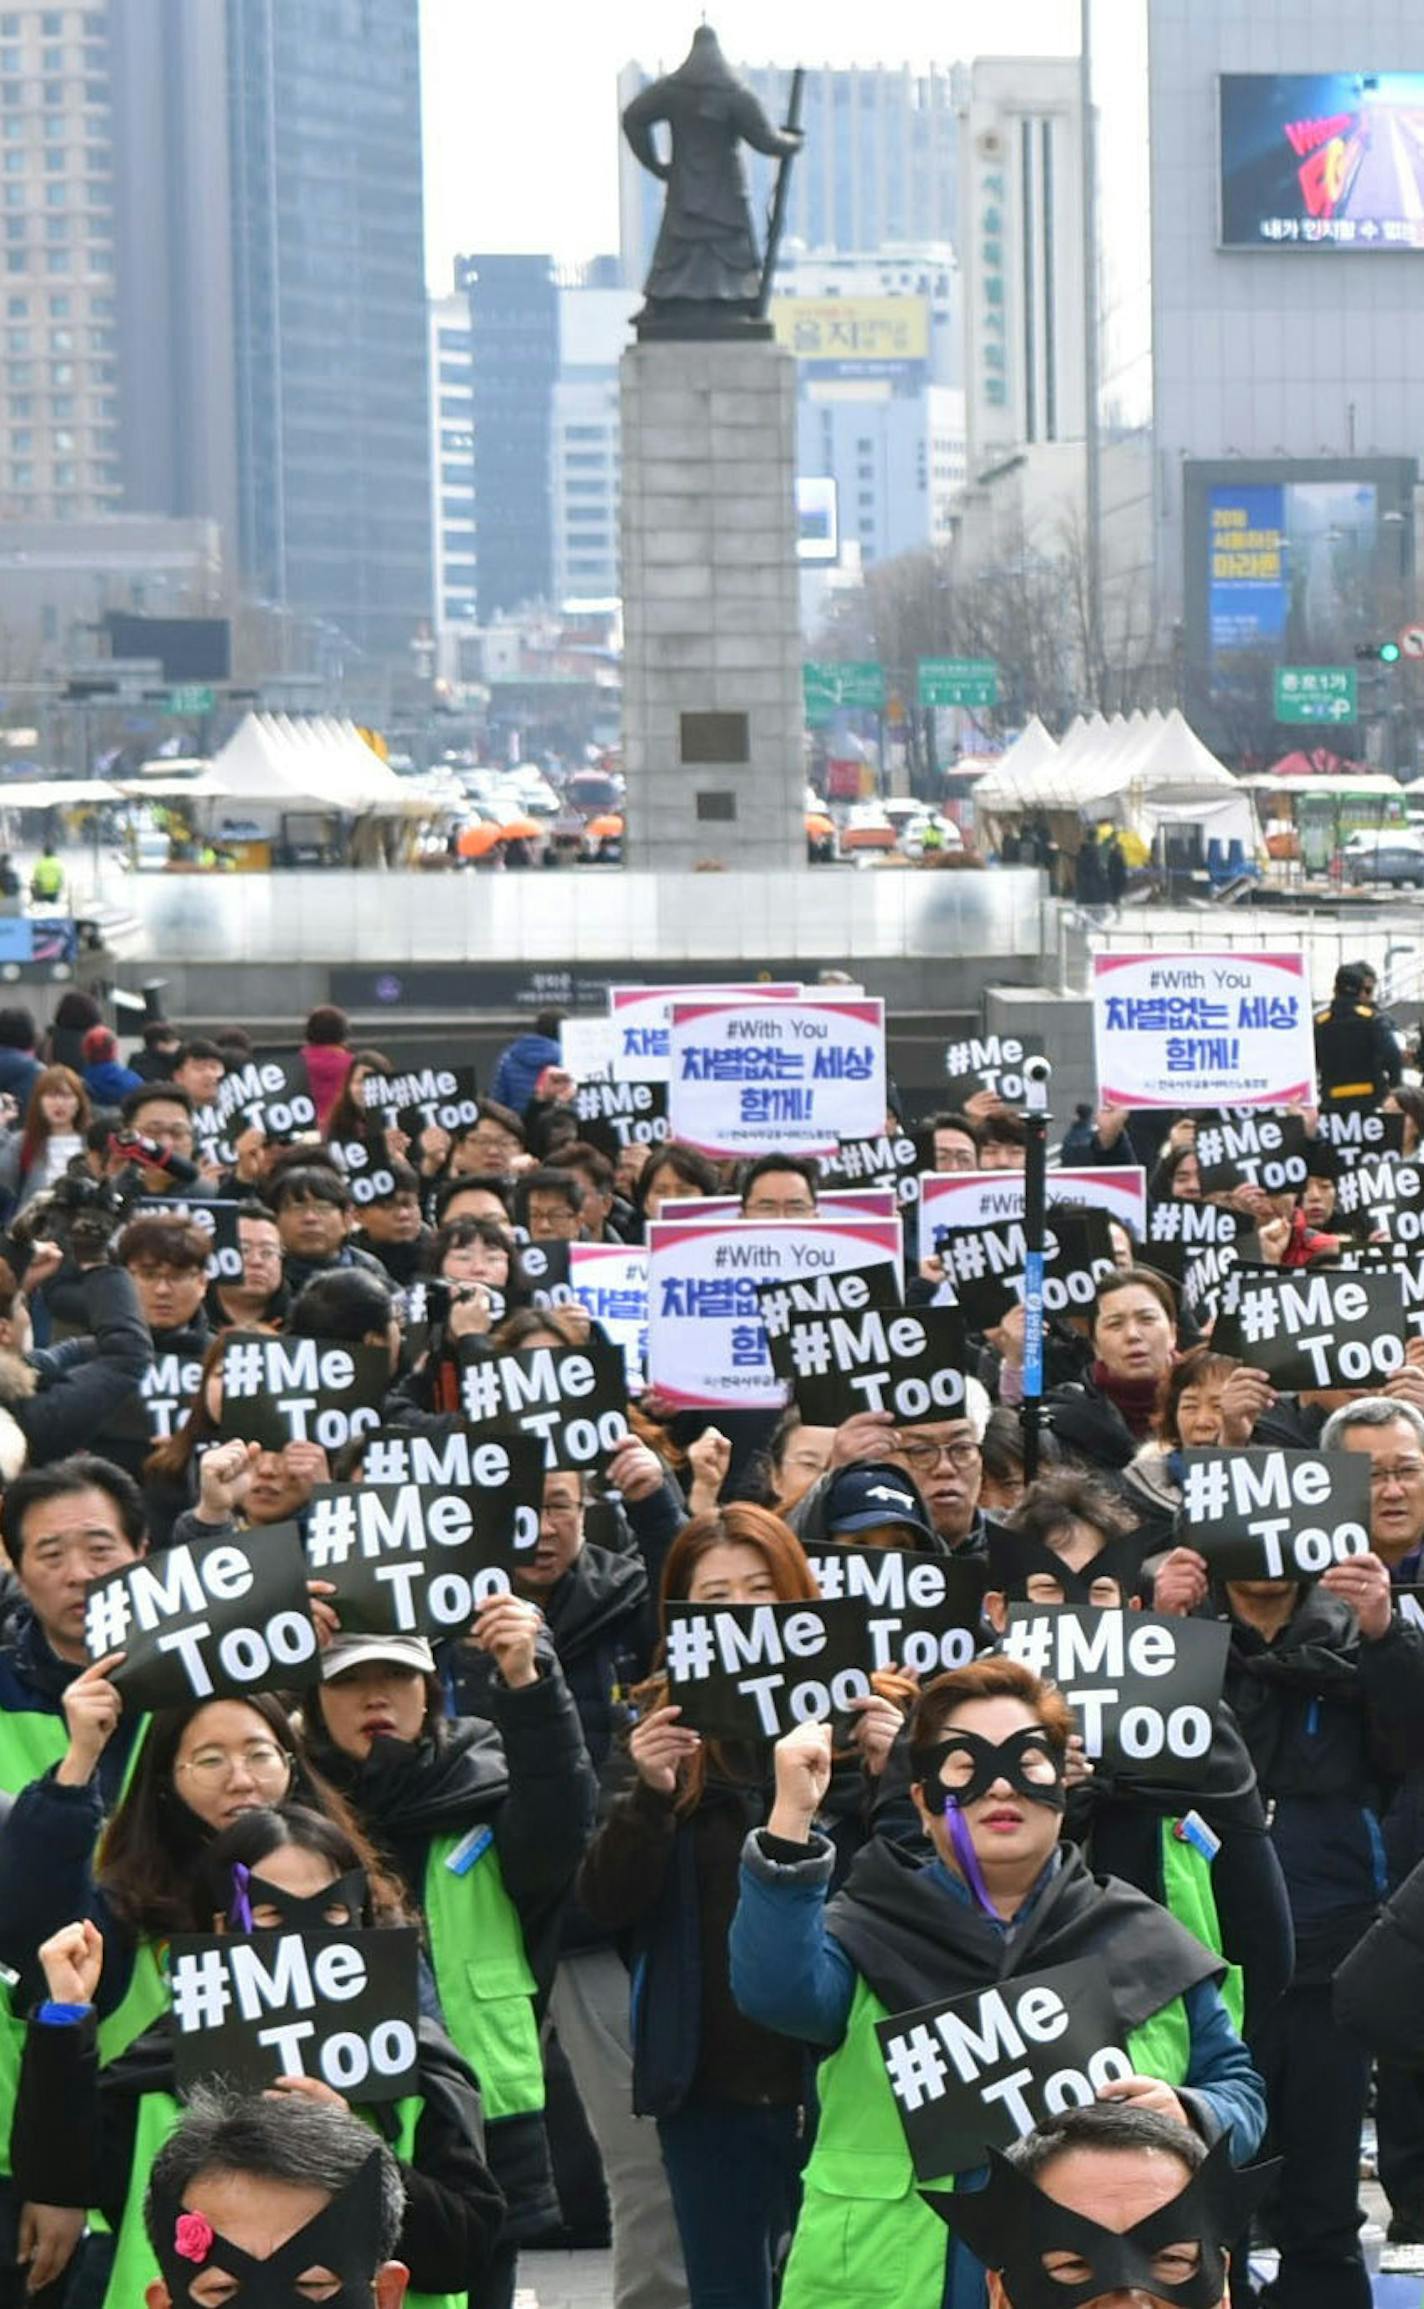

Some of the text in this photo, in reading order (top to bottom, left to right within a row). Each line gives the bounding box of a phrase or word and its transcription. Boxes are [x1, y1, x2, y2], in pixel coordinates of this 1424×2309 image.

[1149, 969, 1252, 989] #With You
[726, 1019, 828, 1039] #With You
[1105, 996, 1299, 1031] 차별없는 세상
[681, 1046, 875, 1081] 차별없는 세상
[947, 1035, 1024, 1077] #Me
[1166, 1037, 1239, 1071] 함께!
[241, 1096, 315, 1134] Too
[418, 1102, 478, 1129] Too
[576, 1083, 653, 1120] #Me
[740, 1087, 814, 1122] 함께!
[610, 1116, 670, 1147] Too
[841, 1137, 918, 1179] #Me
[1196, 1120, 1284, 1167] #Me
[1236, 1156, 1308, 1189] Too
[1338, 1163, 1421, 1214] #Me
[1151, 1203, 1237, 1243] #Me
[715, 1245, 835, 1268] #With You
[760, 1274, 871, 1338] #Me
[1241, 1276, 1370, 1343] #Me
[223, 1338, 355, 1398] #Me
[790, 1311, 928, 1377] #Me
[1296, 1334, 1406, 1387] Too
[463, 1348, 597, 1423] #Me
[850, 1371, 965, 1417] Too
[362, 1432, 511, 1487] #Me
[520, 1411, 628, 1469] Too
[1183, 1452, 1332, 1524] #Me
[306, 1486, 474, 1568] #Me
[1247, 1517, 1370, 1579] Too
[85, 1545, 254, 1659] #Me
[375, 1561, 513, 1631] Too
[806, 1553, 946, 1609] #Me
[156, 1610, 317, 1698] Too
[667, 1606, 828, 1682] #Me
[867, 1618, 975, 1674] Too
[1003, 1609, 1177, 1681] #Me
[738, 1668, 872, 1737] Too
[1066, 1688, 1213, 1759] Too
[172, 1934, 368, 2033] #Me
[257, 2019, 417, 2088] Too
[885, 1987, 1069, 2112] #Me
